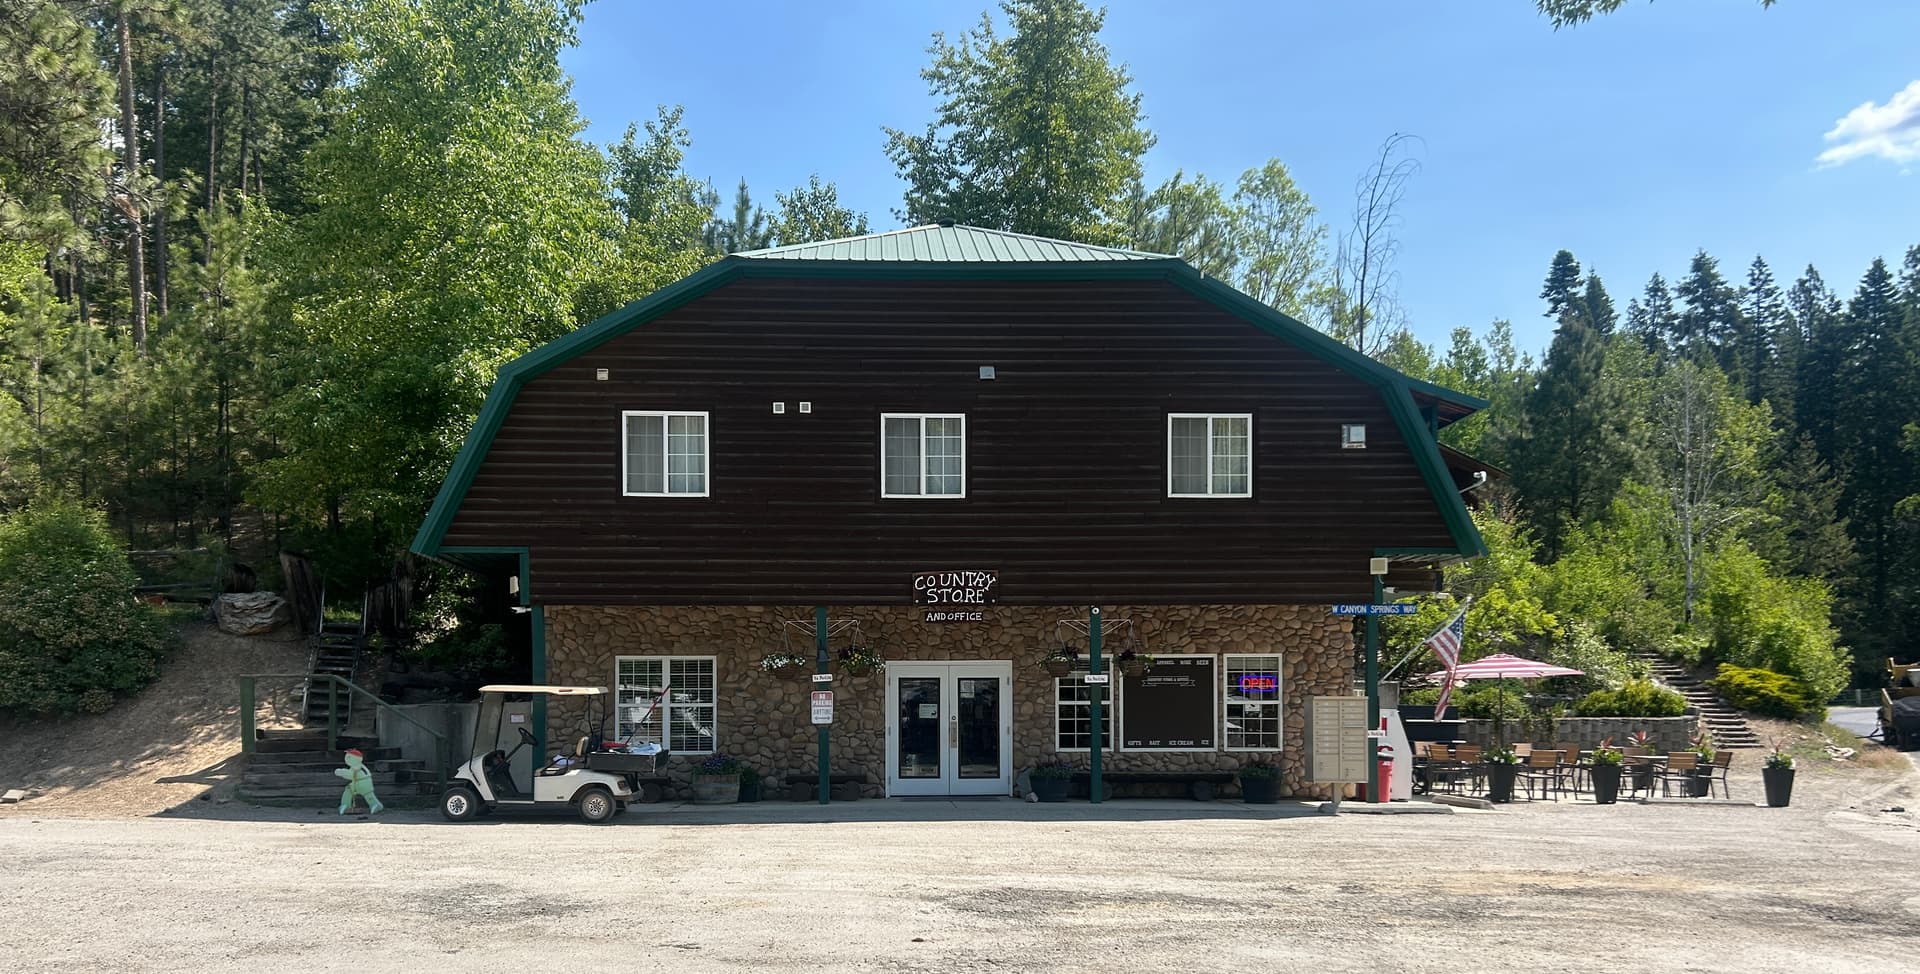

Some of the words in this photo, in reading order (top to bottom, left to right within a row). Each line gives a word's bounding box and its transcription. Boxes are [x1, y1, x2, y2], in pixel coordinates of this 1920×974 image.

[915, 571, 996, 591] COUNTRY
[927, 588, 984, 604] STORE
[1332, 605, 1338, 613] W
[1340, 605, 1367, 613] CANYON
[1370, 605, 1399, 613] SPRINGS
[1403, 605, 1417, 613] WAY
[925, 612, 946, 621] AND
[947, 612, 983, 621] OFFICE
[1242, 678, 1274, 689] OPEN
